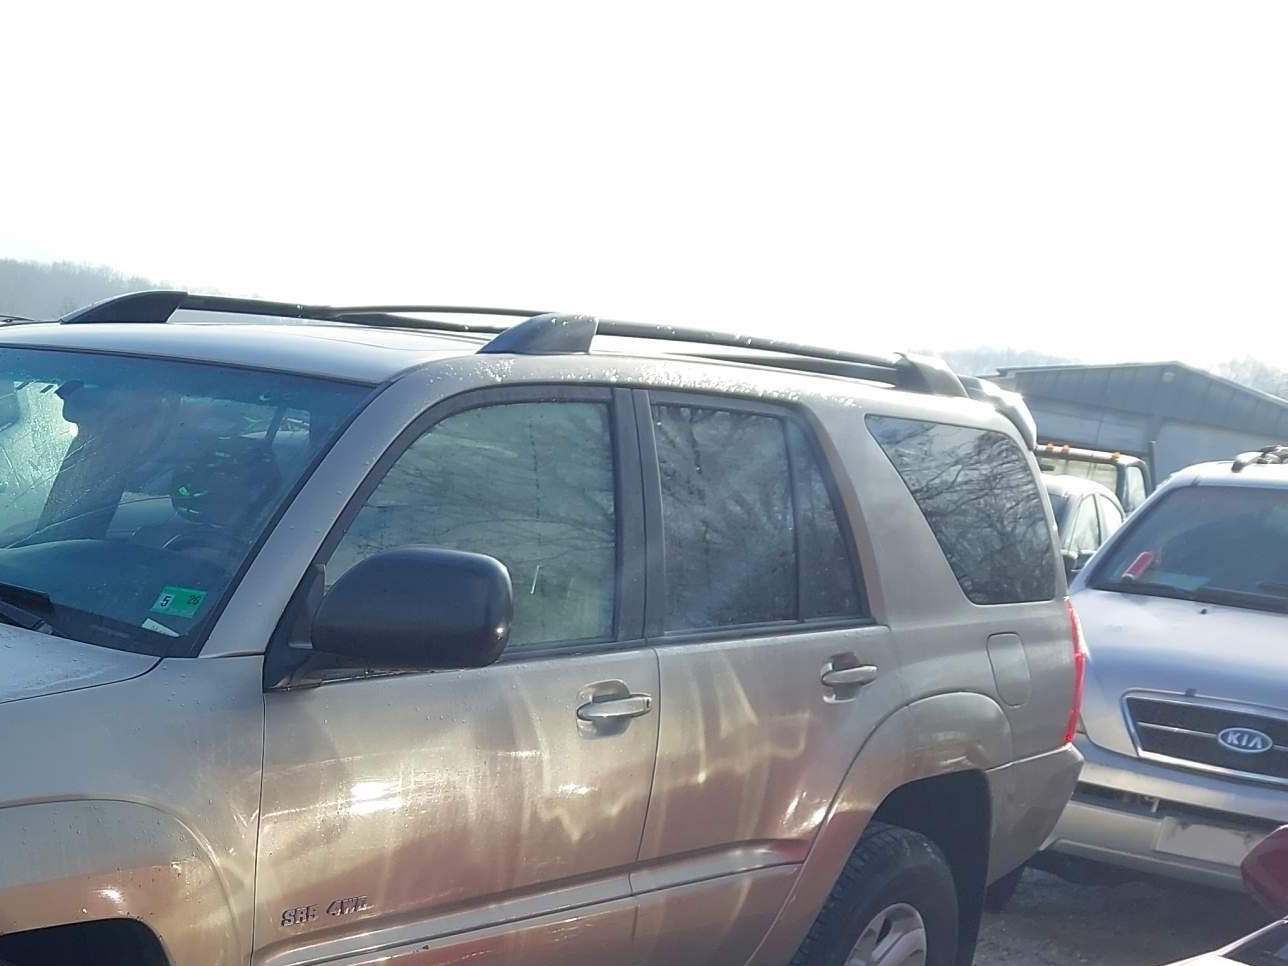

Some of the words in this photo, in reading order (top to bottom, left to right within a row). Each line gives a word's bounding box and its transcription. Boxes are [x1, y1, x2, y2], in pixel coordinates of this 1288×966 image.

[160, 595, 172, 607] 5
[1227, 731, 1262, 749] KIA
[281, 904, 320, 926] SR5
